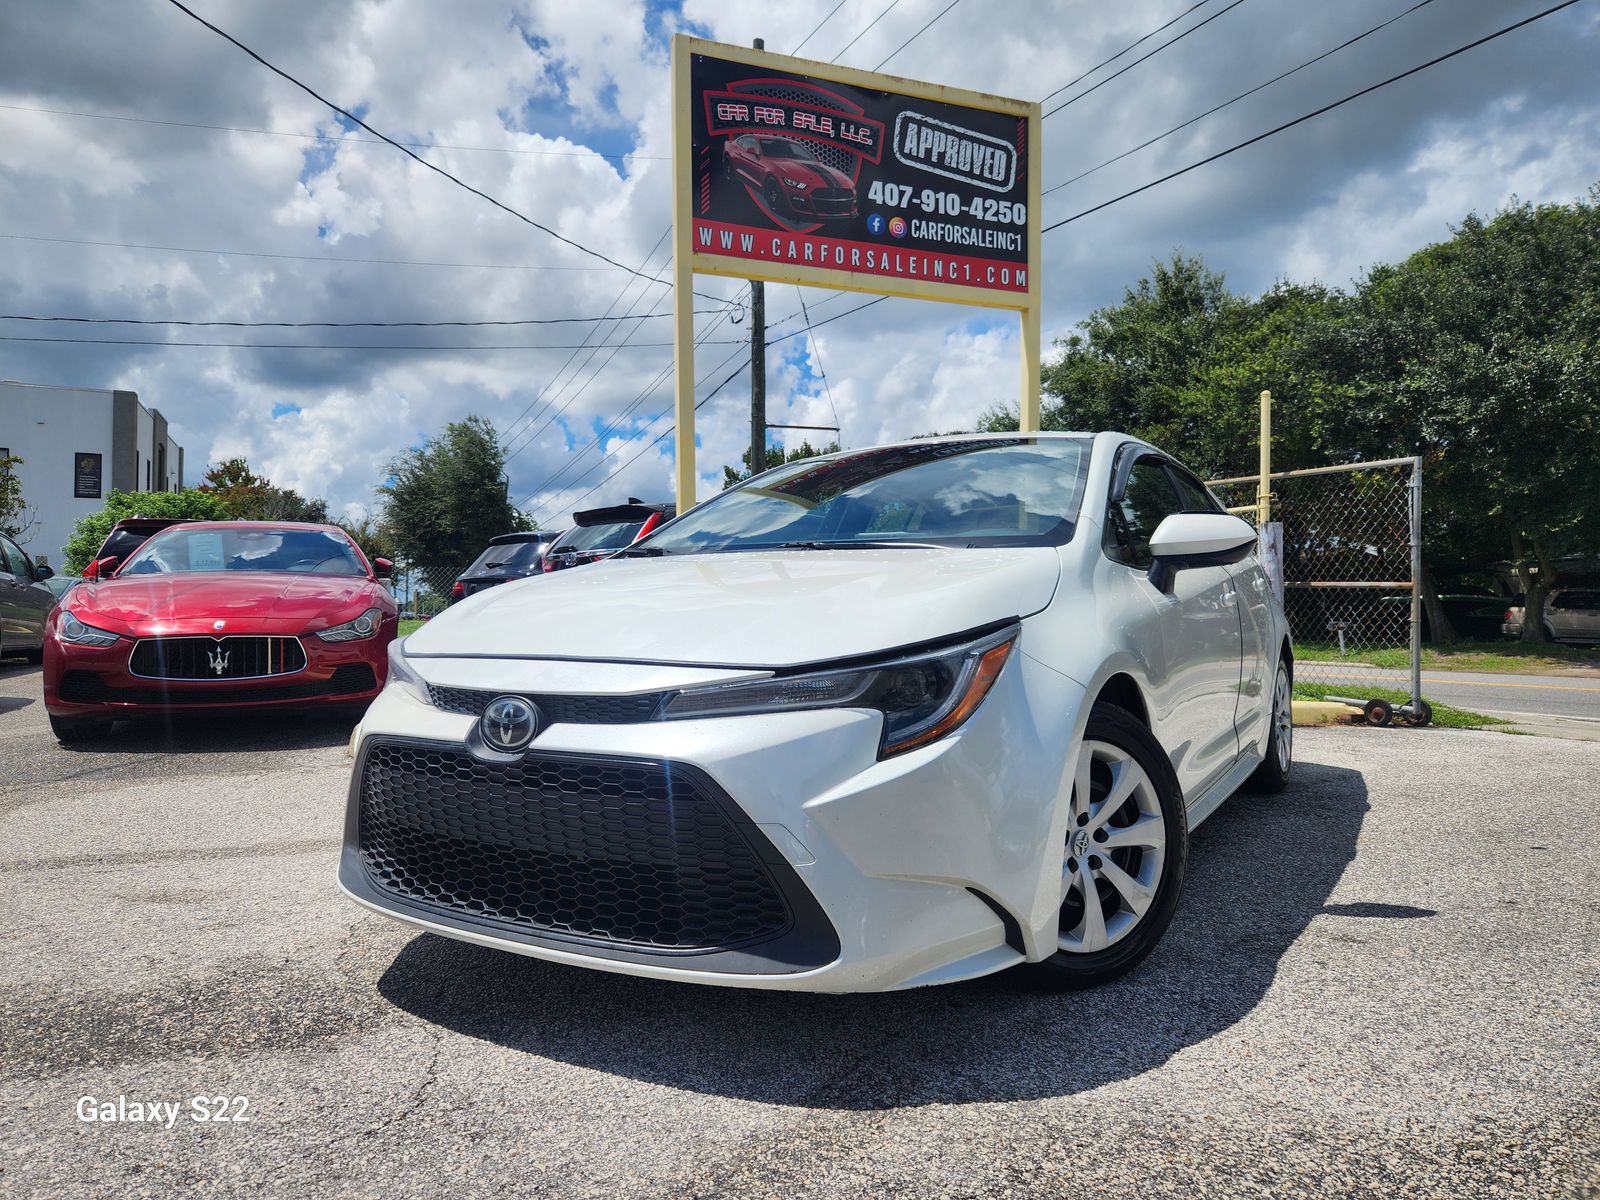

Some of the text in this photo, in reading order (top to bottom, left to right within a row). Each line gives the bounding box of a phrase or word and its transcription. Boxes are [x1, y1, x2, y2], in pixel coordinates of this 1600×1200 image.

[717, 103, 873, 145] CAR FOR SALE, LLC.
[904, 123, 1007, 182] APPROVED
[868, 180, 1027, 226] 407-910-4250
[699, 226, 1027, 287] WWW.CARFORSALEINC1.COM
[911, 219, 1022, 251] CARFORSALEINC1
